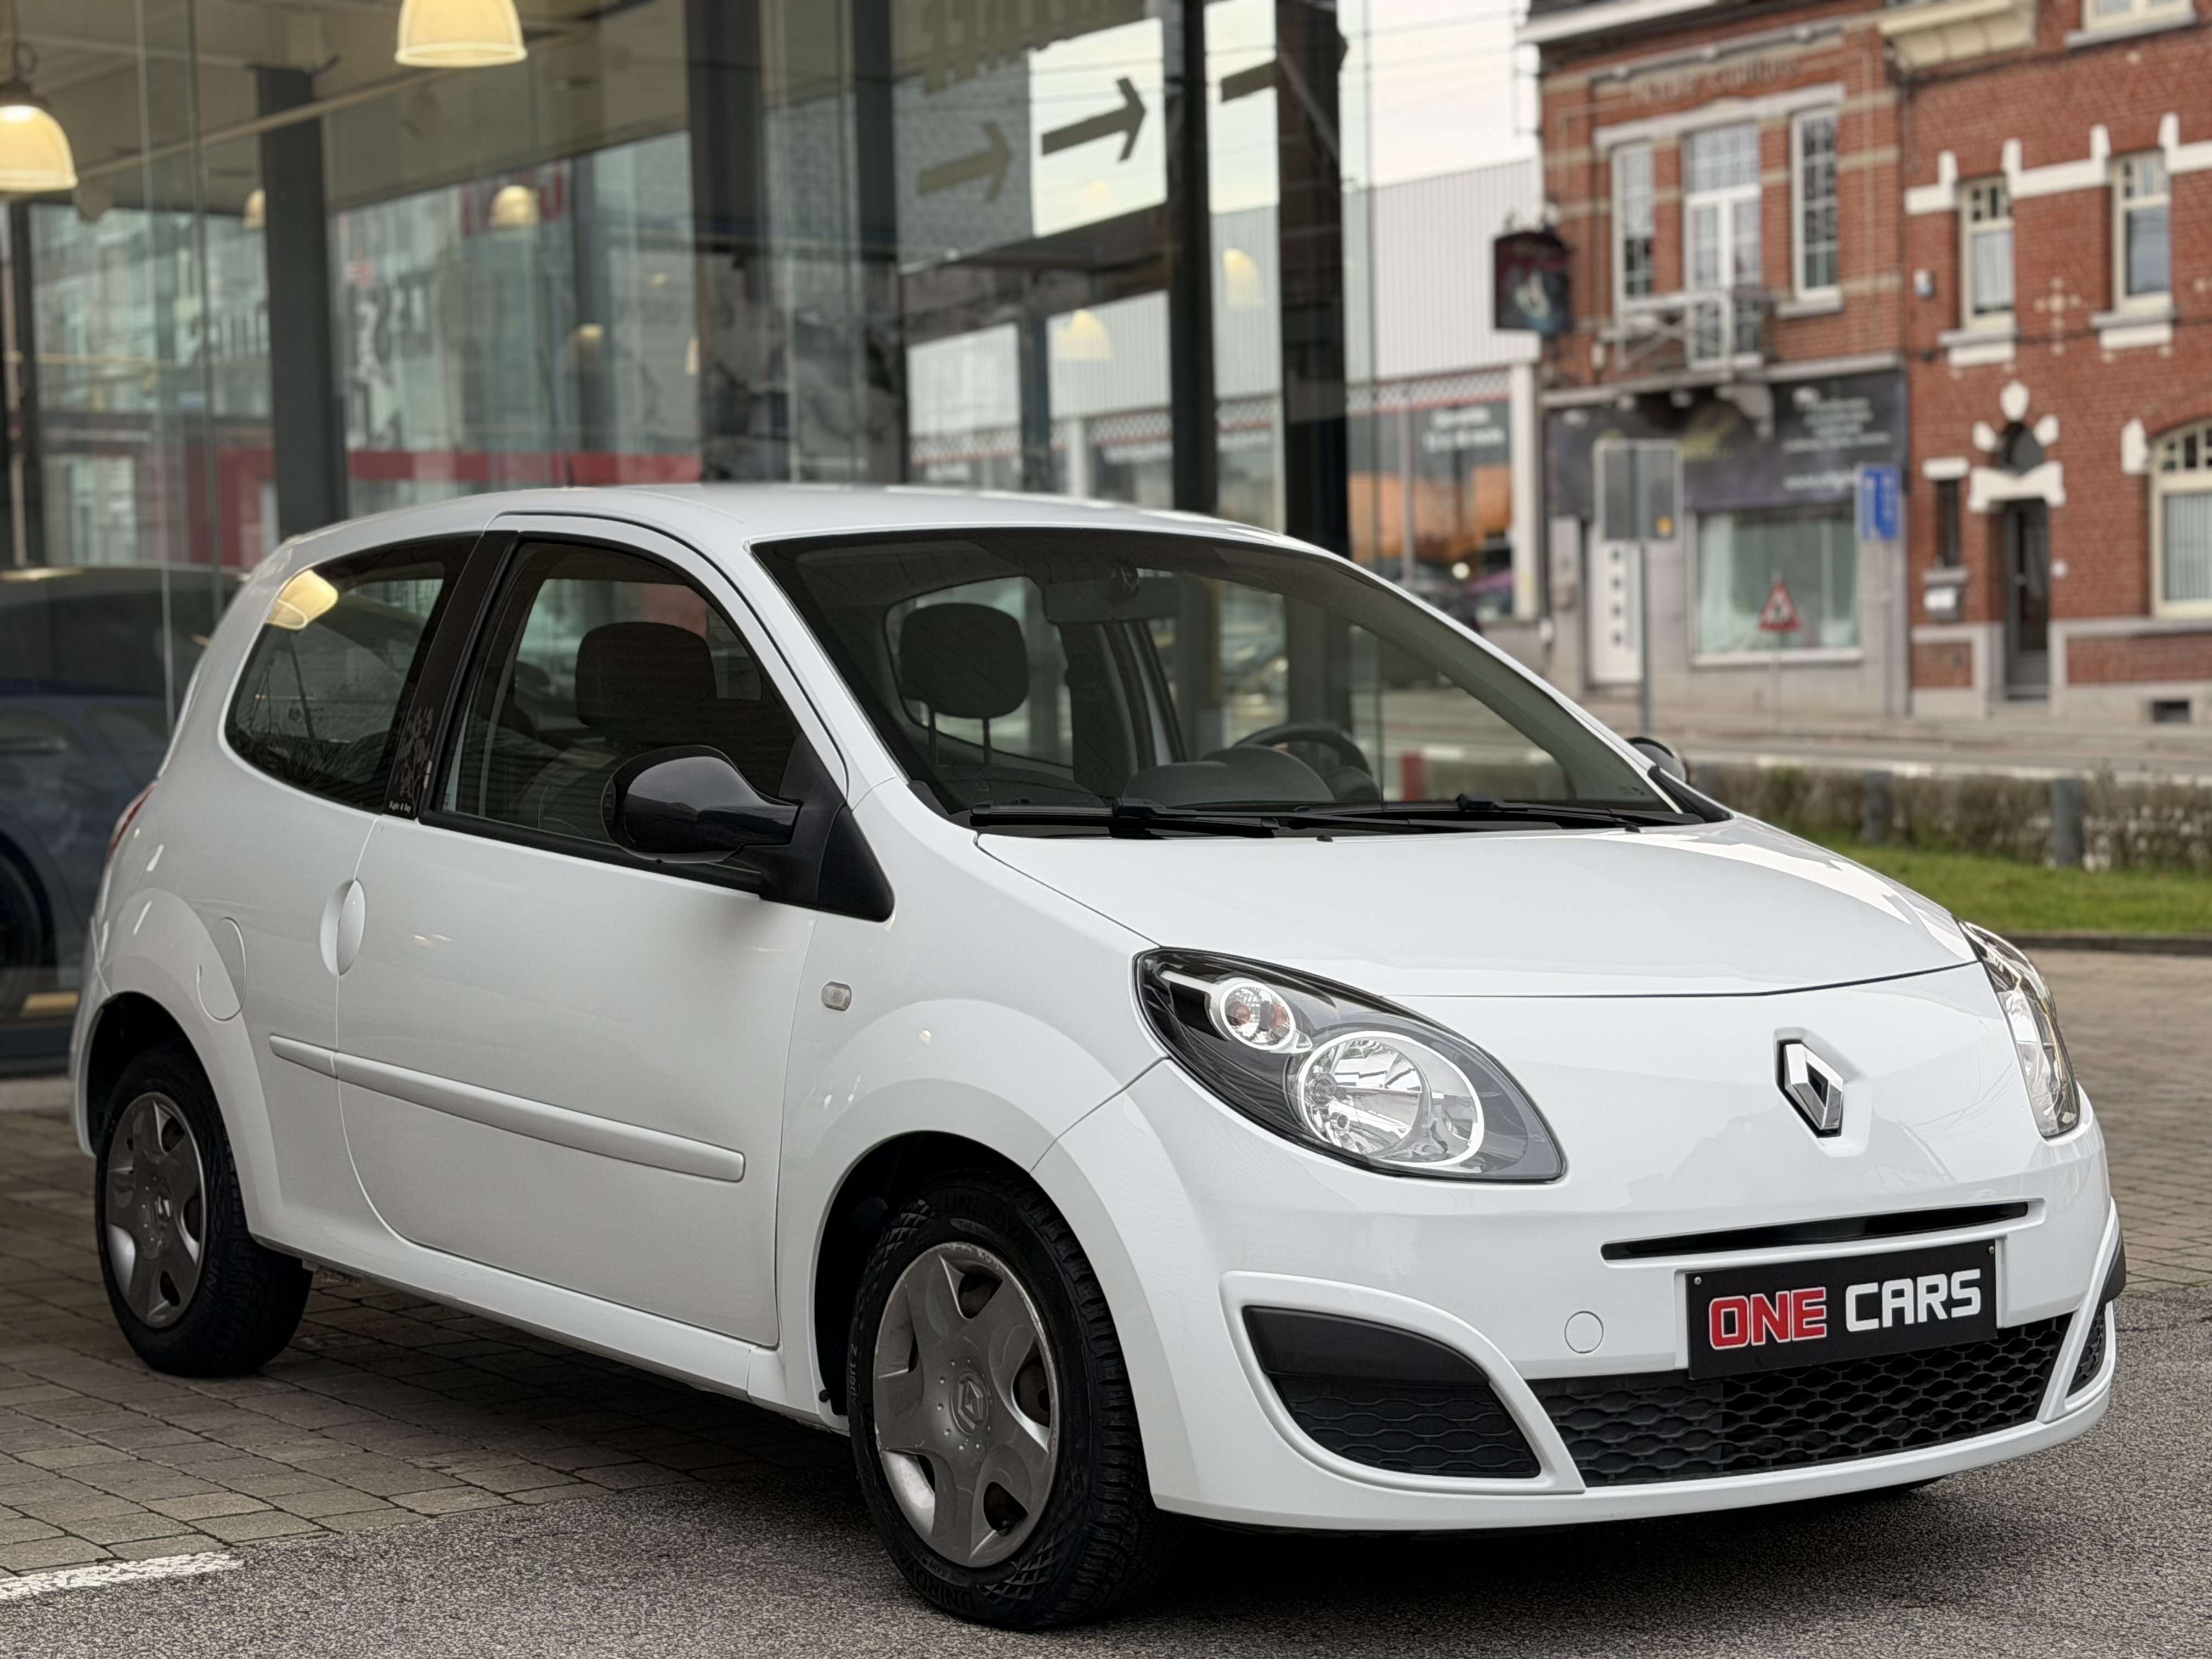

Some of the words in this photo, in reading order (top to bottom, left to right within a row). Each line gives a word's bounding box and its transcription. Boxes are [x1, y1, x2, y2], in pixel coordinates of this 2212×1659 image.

[1709, 1286, 1826, 1350] ONE
[1846, 1268, 1980, 1332] CARS
[849, 1343, 857, 1357] 2
